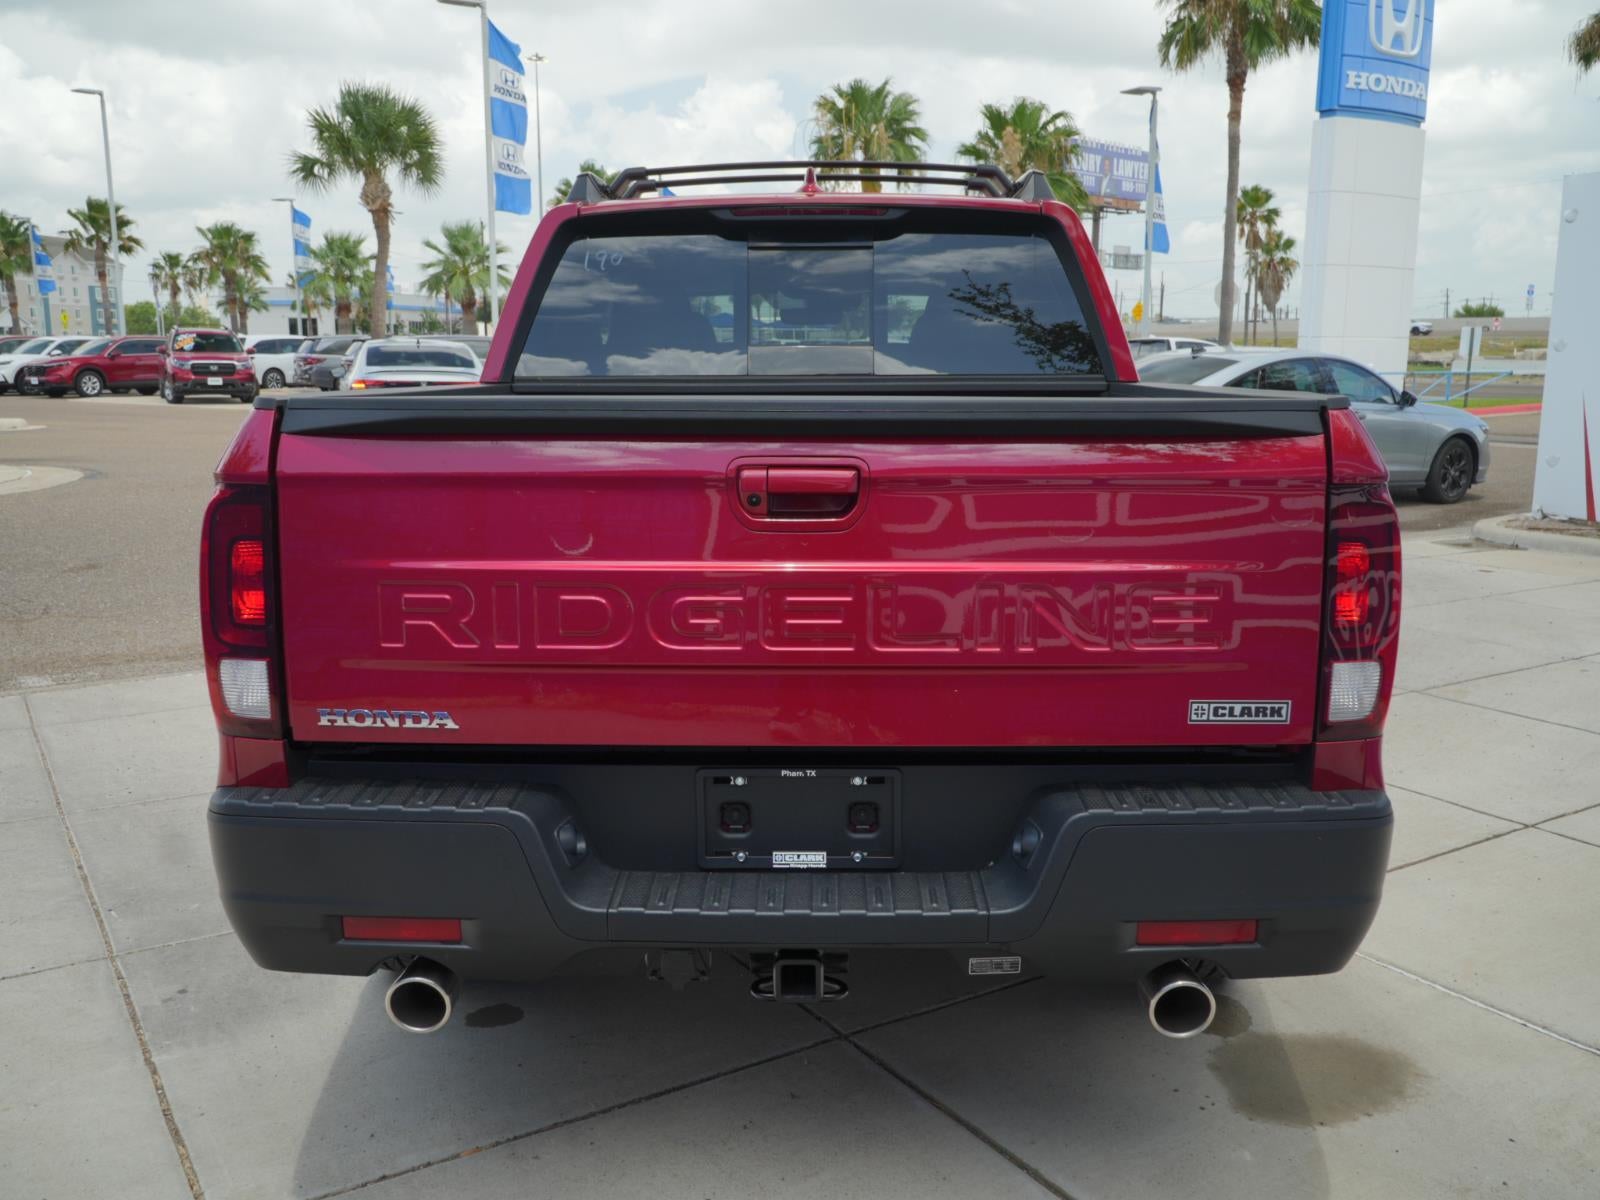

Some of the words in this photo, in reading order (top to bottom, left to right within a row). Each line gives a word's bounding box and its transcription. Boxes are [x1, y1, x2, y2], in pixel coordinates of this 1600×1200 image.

[494, 83, 527, 102] HONDA
[1345, 70, 1427, 101] HONDA
[1113, 157, 1149, 181] LAWYER
[584, 250, 624, 271] 190
[378, 581, 1222, 652] RIDGELINE
[316, 708, 460, 729] HONDA
[1212, 705, 1284, 719] CLARK
[805, 769, 817, 777] TX
[784, 854, 824, 862] CLARK
